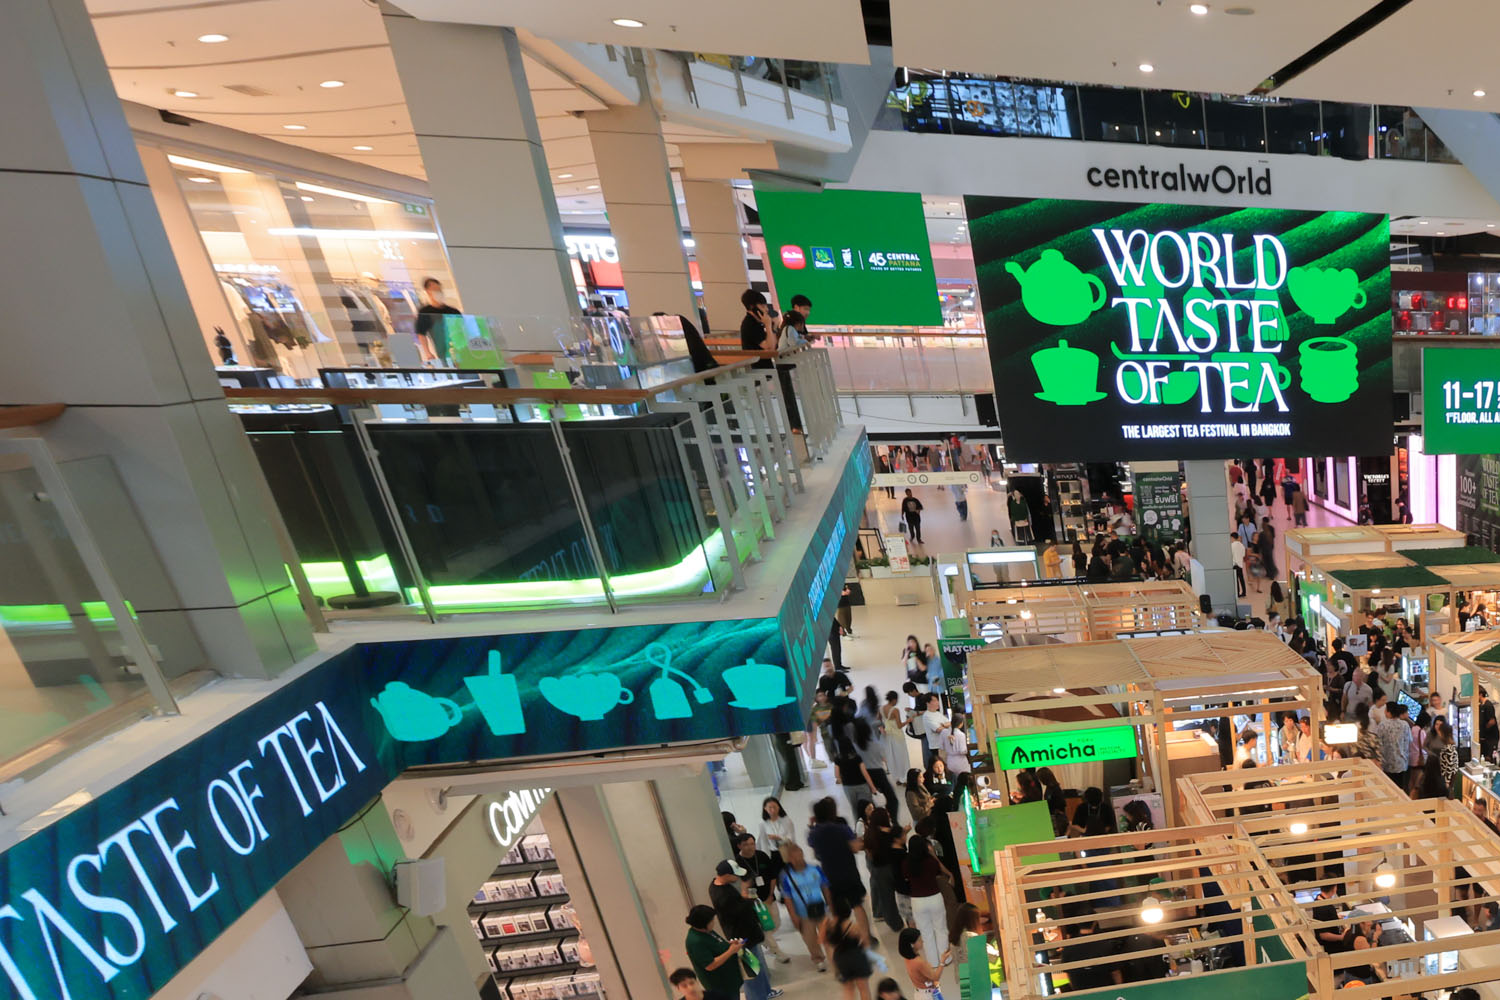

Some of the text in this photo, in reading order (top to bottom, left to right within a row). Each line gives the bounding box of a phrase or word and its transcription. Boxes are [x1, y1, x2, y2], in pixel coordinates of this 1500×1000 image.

[887, 253, 920, 261] CENTRAL
[1091, 228, 1287, 290] WORLD
[1111, 297, 1282, 353] TASTE
[1116, 361, 1290, 413] OF TEA
[1480, 412, 1493, 423] ALL
[1122, 423, 1291, 438] THE LARGEST TEA FESTIVAL IN BANGKOK
[1460, 475, 1477, 495] 100+
[943, 645, 983, 654] MATCHA
[1010, 743, 1095, 765] Amicha
[206, 761, 269, 857] OF
[259, 700, 367, 820] TEA
